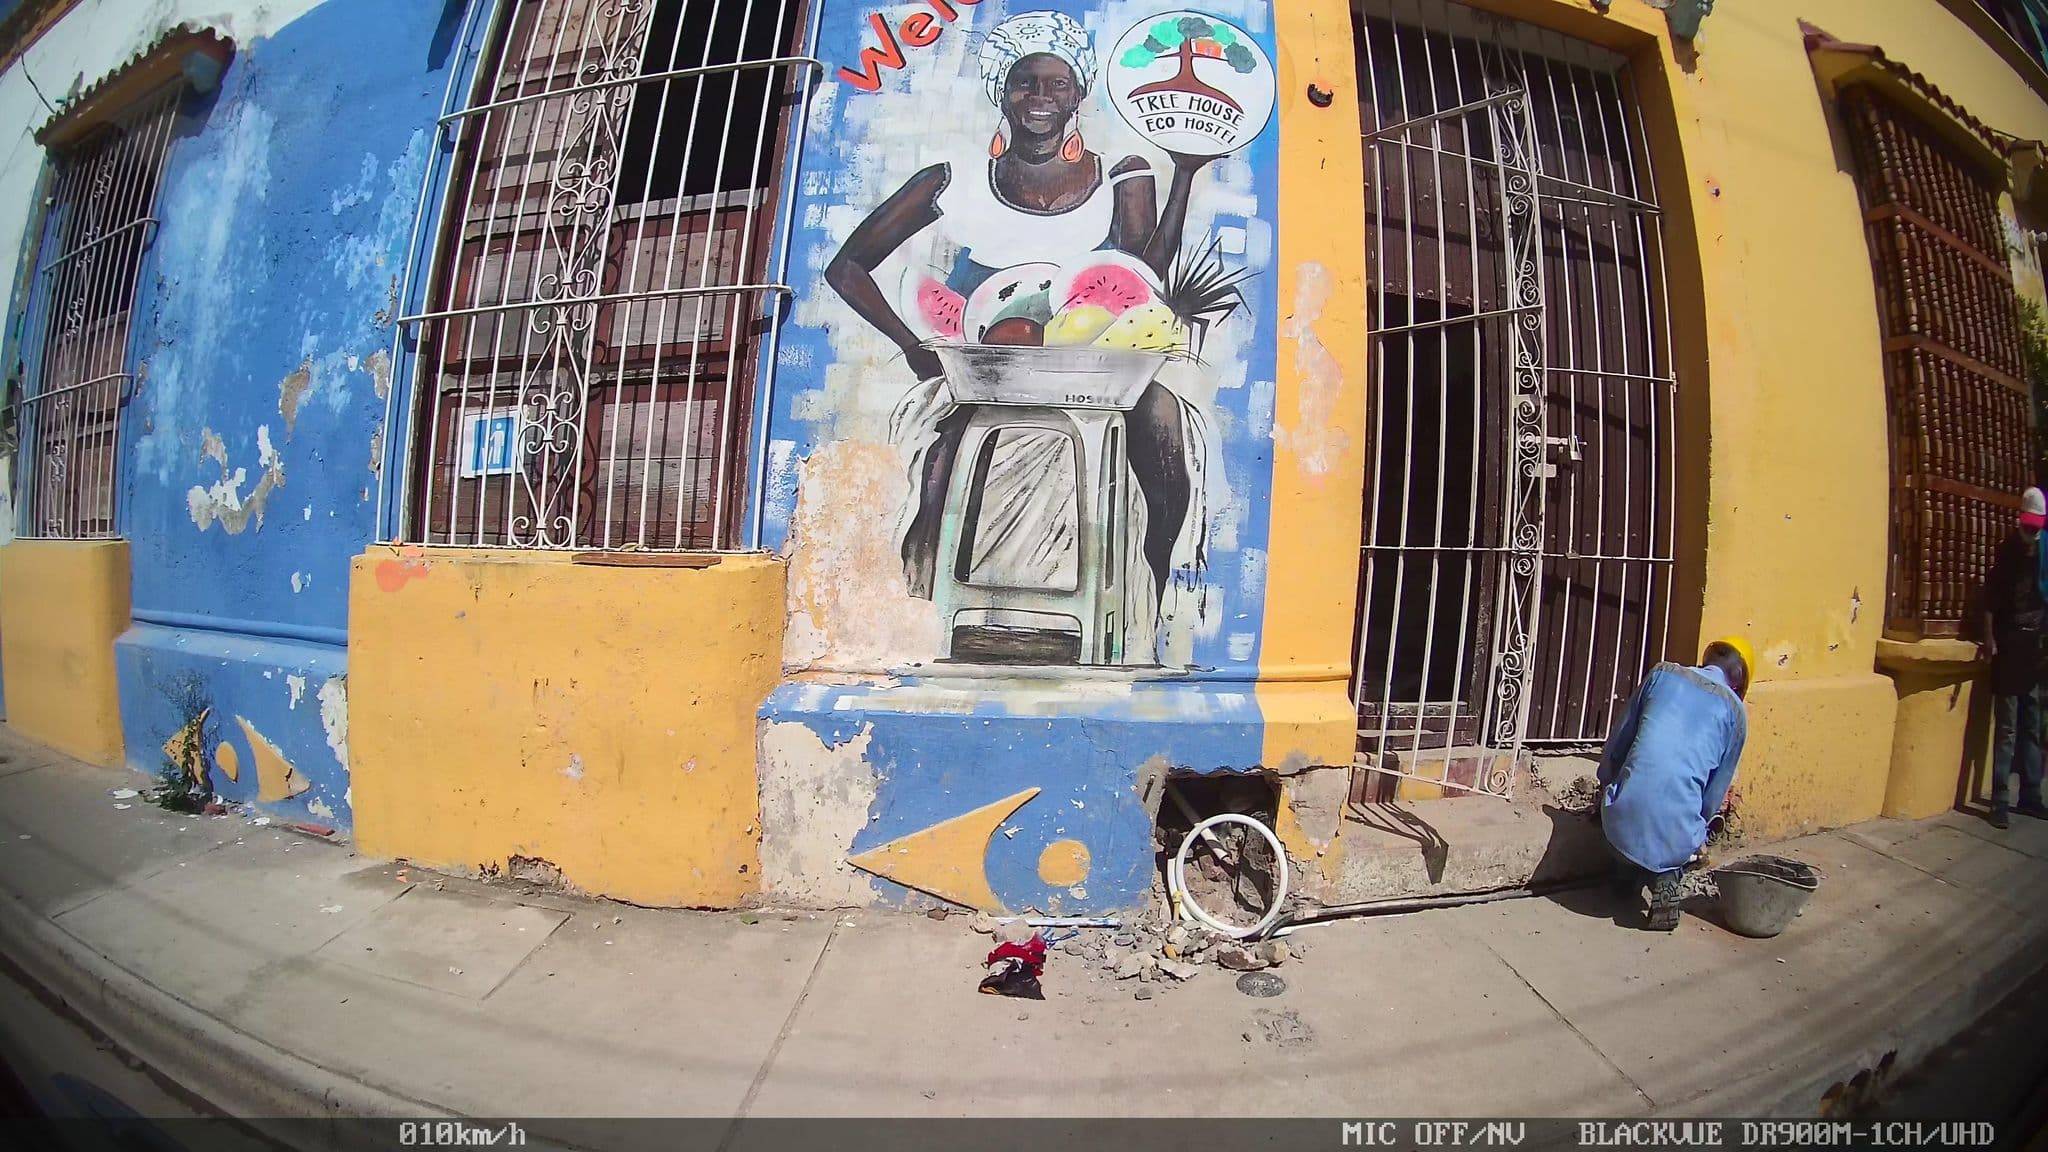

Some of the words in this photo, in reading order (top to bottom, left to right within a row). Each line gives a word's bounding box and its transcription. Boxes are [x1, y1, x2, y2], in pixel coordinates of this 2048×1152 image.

[837, 0, 984, 92] We
[1130, 93, 1180, 114] TREE
[1188, 96, 1246, 127] HOUSE
[1145, 116, 1176, 133] ECO
